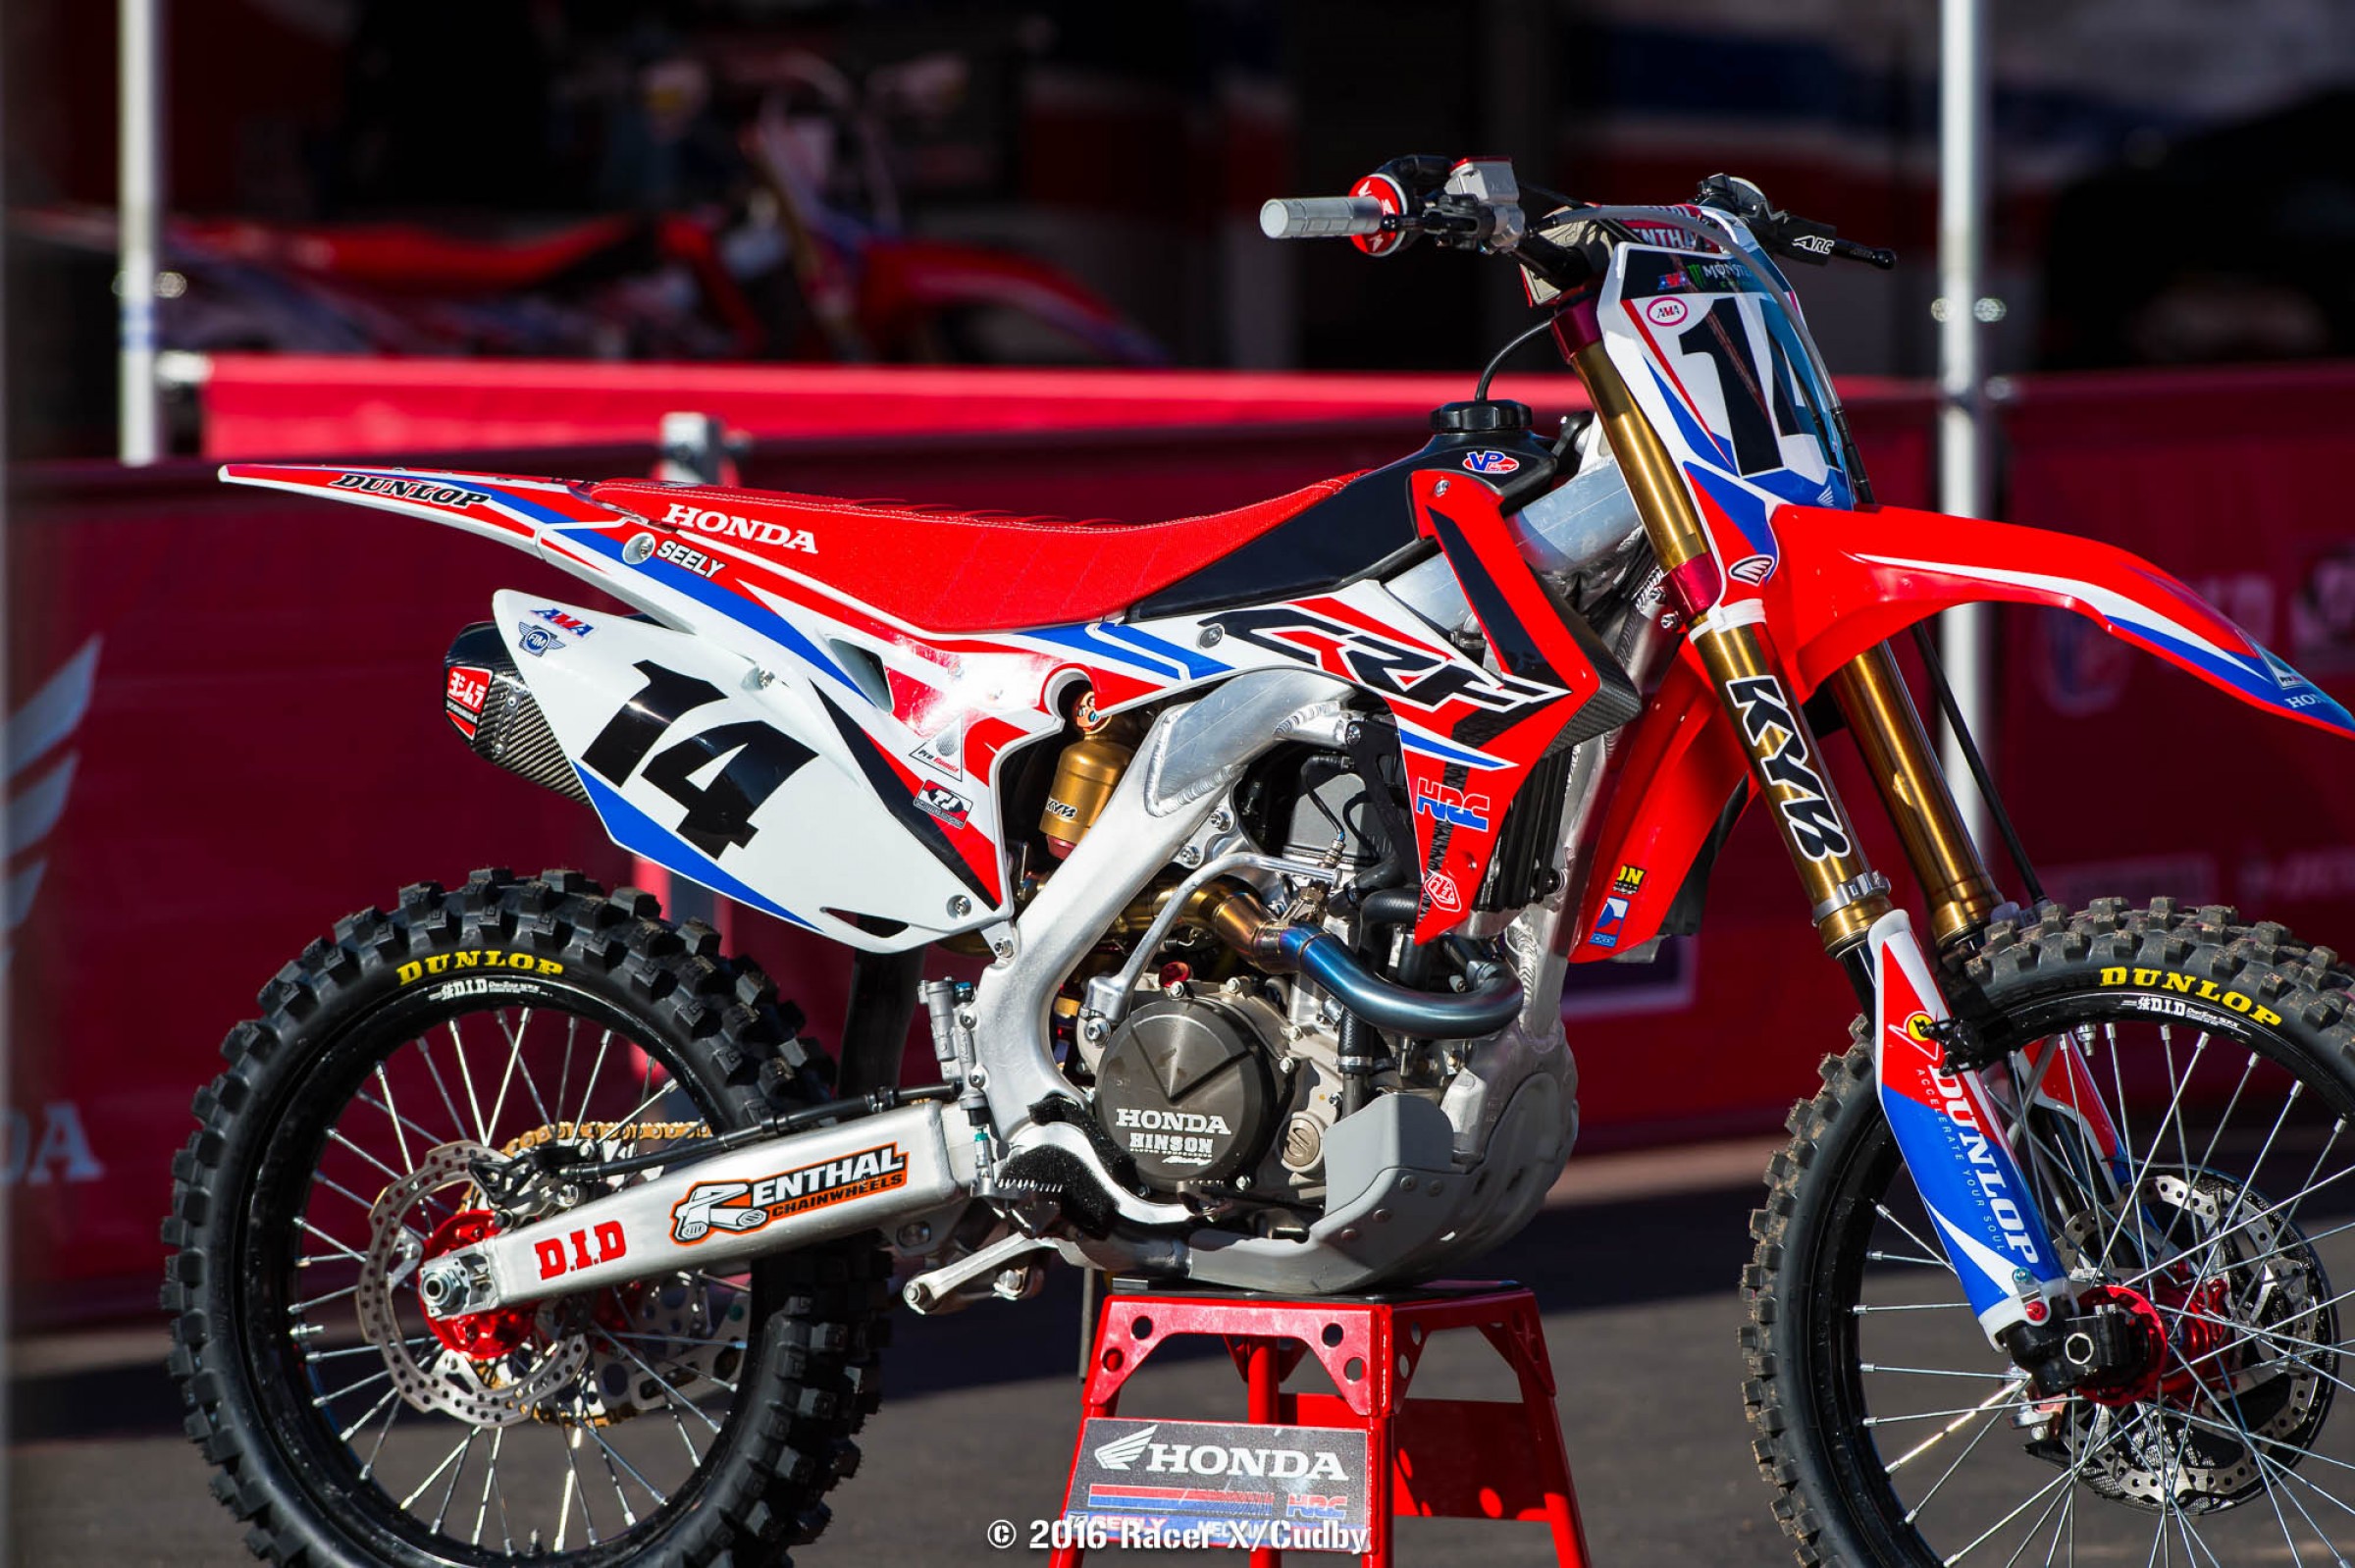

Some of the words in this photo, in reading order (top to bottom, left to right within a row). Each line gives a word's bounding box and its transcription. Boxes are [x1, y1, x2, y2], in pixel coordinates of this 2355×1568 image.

[1792, 235, 1835, 254] ARC
[1656, 304, 1680, 318] AMA
[1467, 450, 1505, 472] VP
[330, 474, 491, 507] DUNLOP
[661, 502, 819, 554] HONDA
[656, 540, 726, 579] SEELY
[529, 607, 595, 639] AMA
[581, 658, 819, 861] 14
[1725, 674, 1852, 862] KYB
[1045, 797, 1078, 819] KYB
[1416, 776, 1491, 833] HRC
[395, 950, 564, 986] DUNLOP
[2100, 967, 2283, 1027] DUNLOP
[1115, 1108, 1232, 1136] HONDA
[1128, 1132, 1214, 1154] HINSON
[1915, 1068, 1965, 1162] ACCELERATE
[1962, 1170, 1985, 1207] YOUR
[1983, 1215, 2005, 1251] SOUL
[1926, 1064, 2040, 1265] DUNLOP
[771, 1173, 904, 1219] CHAINWHEELS
[535, 1220, 627, 1281] D.I.D
[1145, 1442, 1350, 1482] HONDA
[1090, 1515, 1169, 1533] SELY
[1285, 1492, 1349, 1520] HRC
